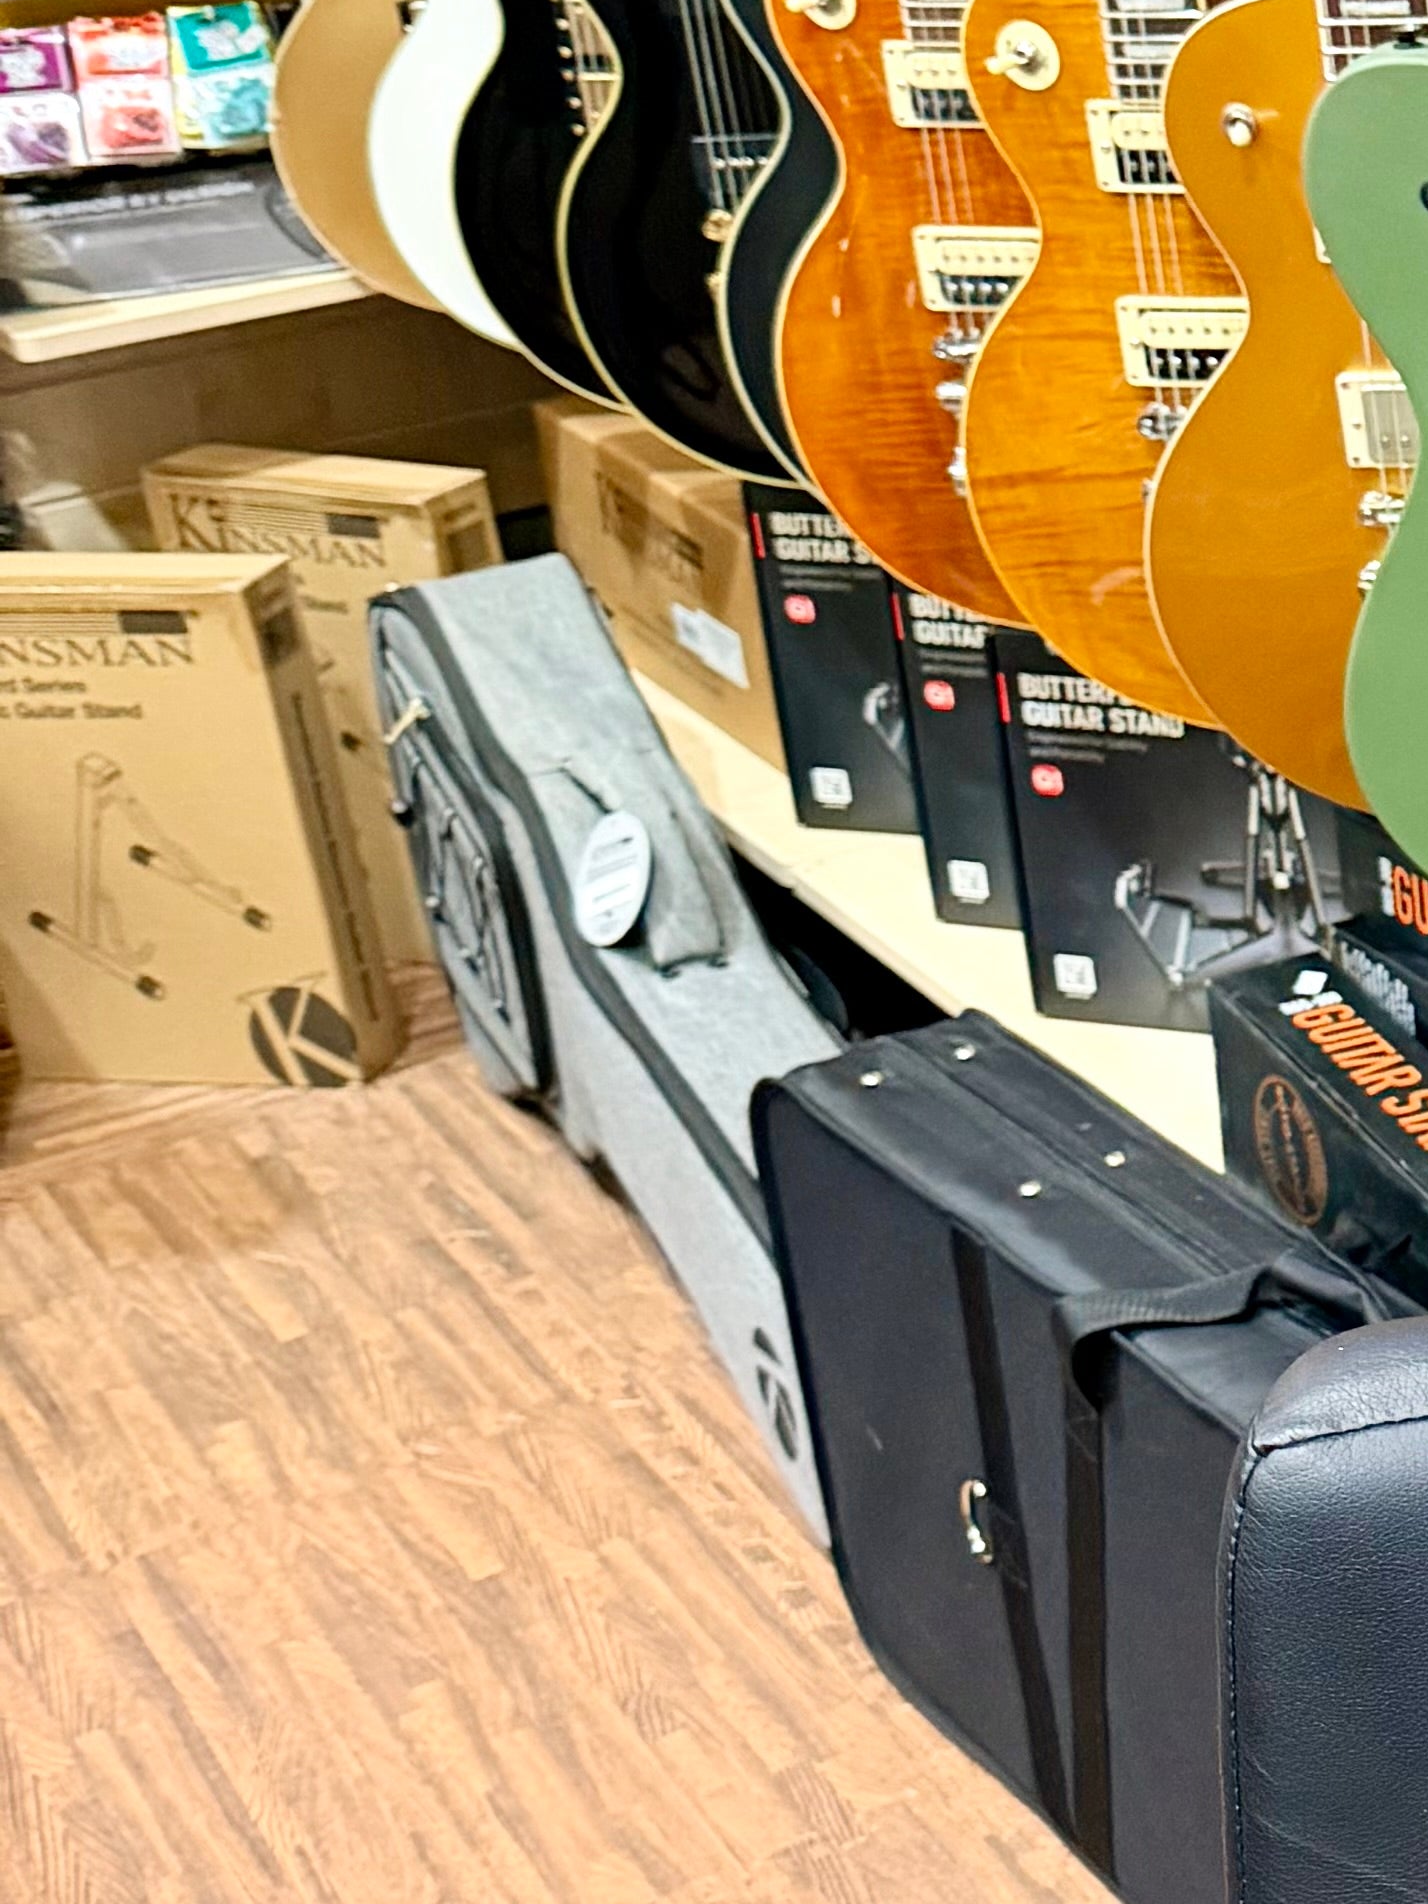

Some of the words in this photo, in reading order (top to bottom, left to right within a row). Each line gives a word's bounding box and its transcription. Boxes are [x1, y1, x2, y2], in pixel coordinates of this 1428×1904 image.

[771, 536, 852, 563] GUITAR
[1021, 700, 1106, 734] GUITAR
[1108, 707, 1186, 739] STAND
[1291, 1003, 1422, 1097] GUITAR
